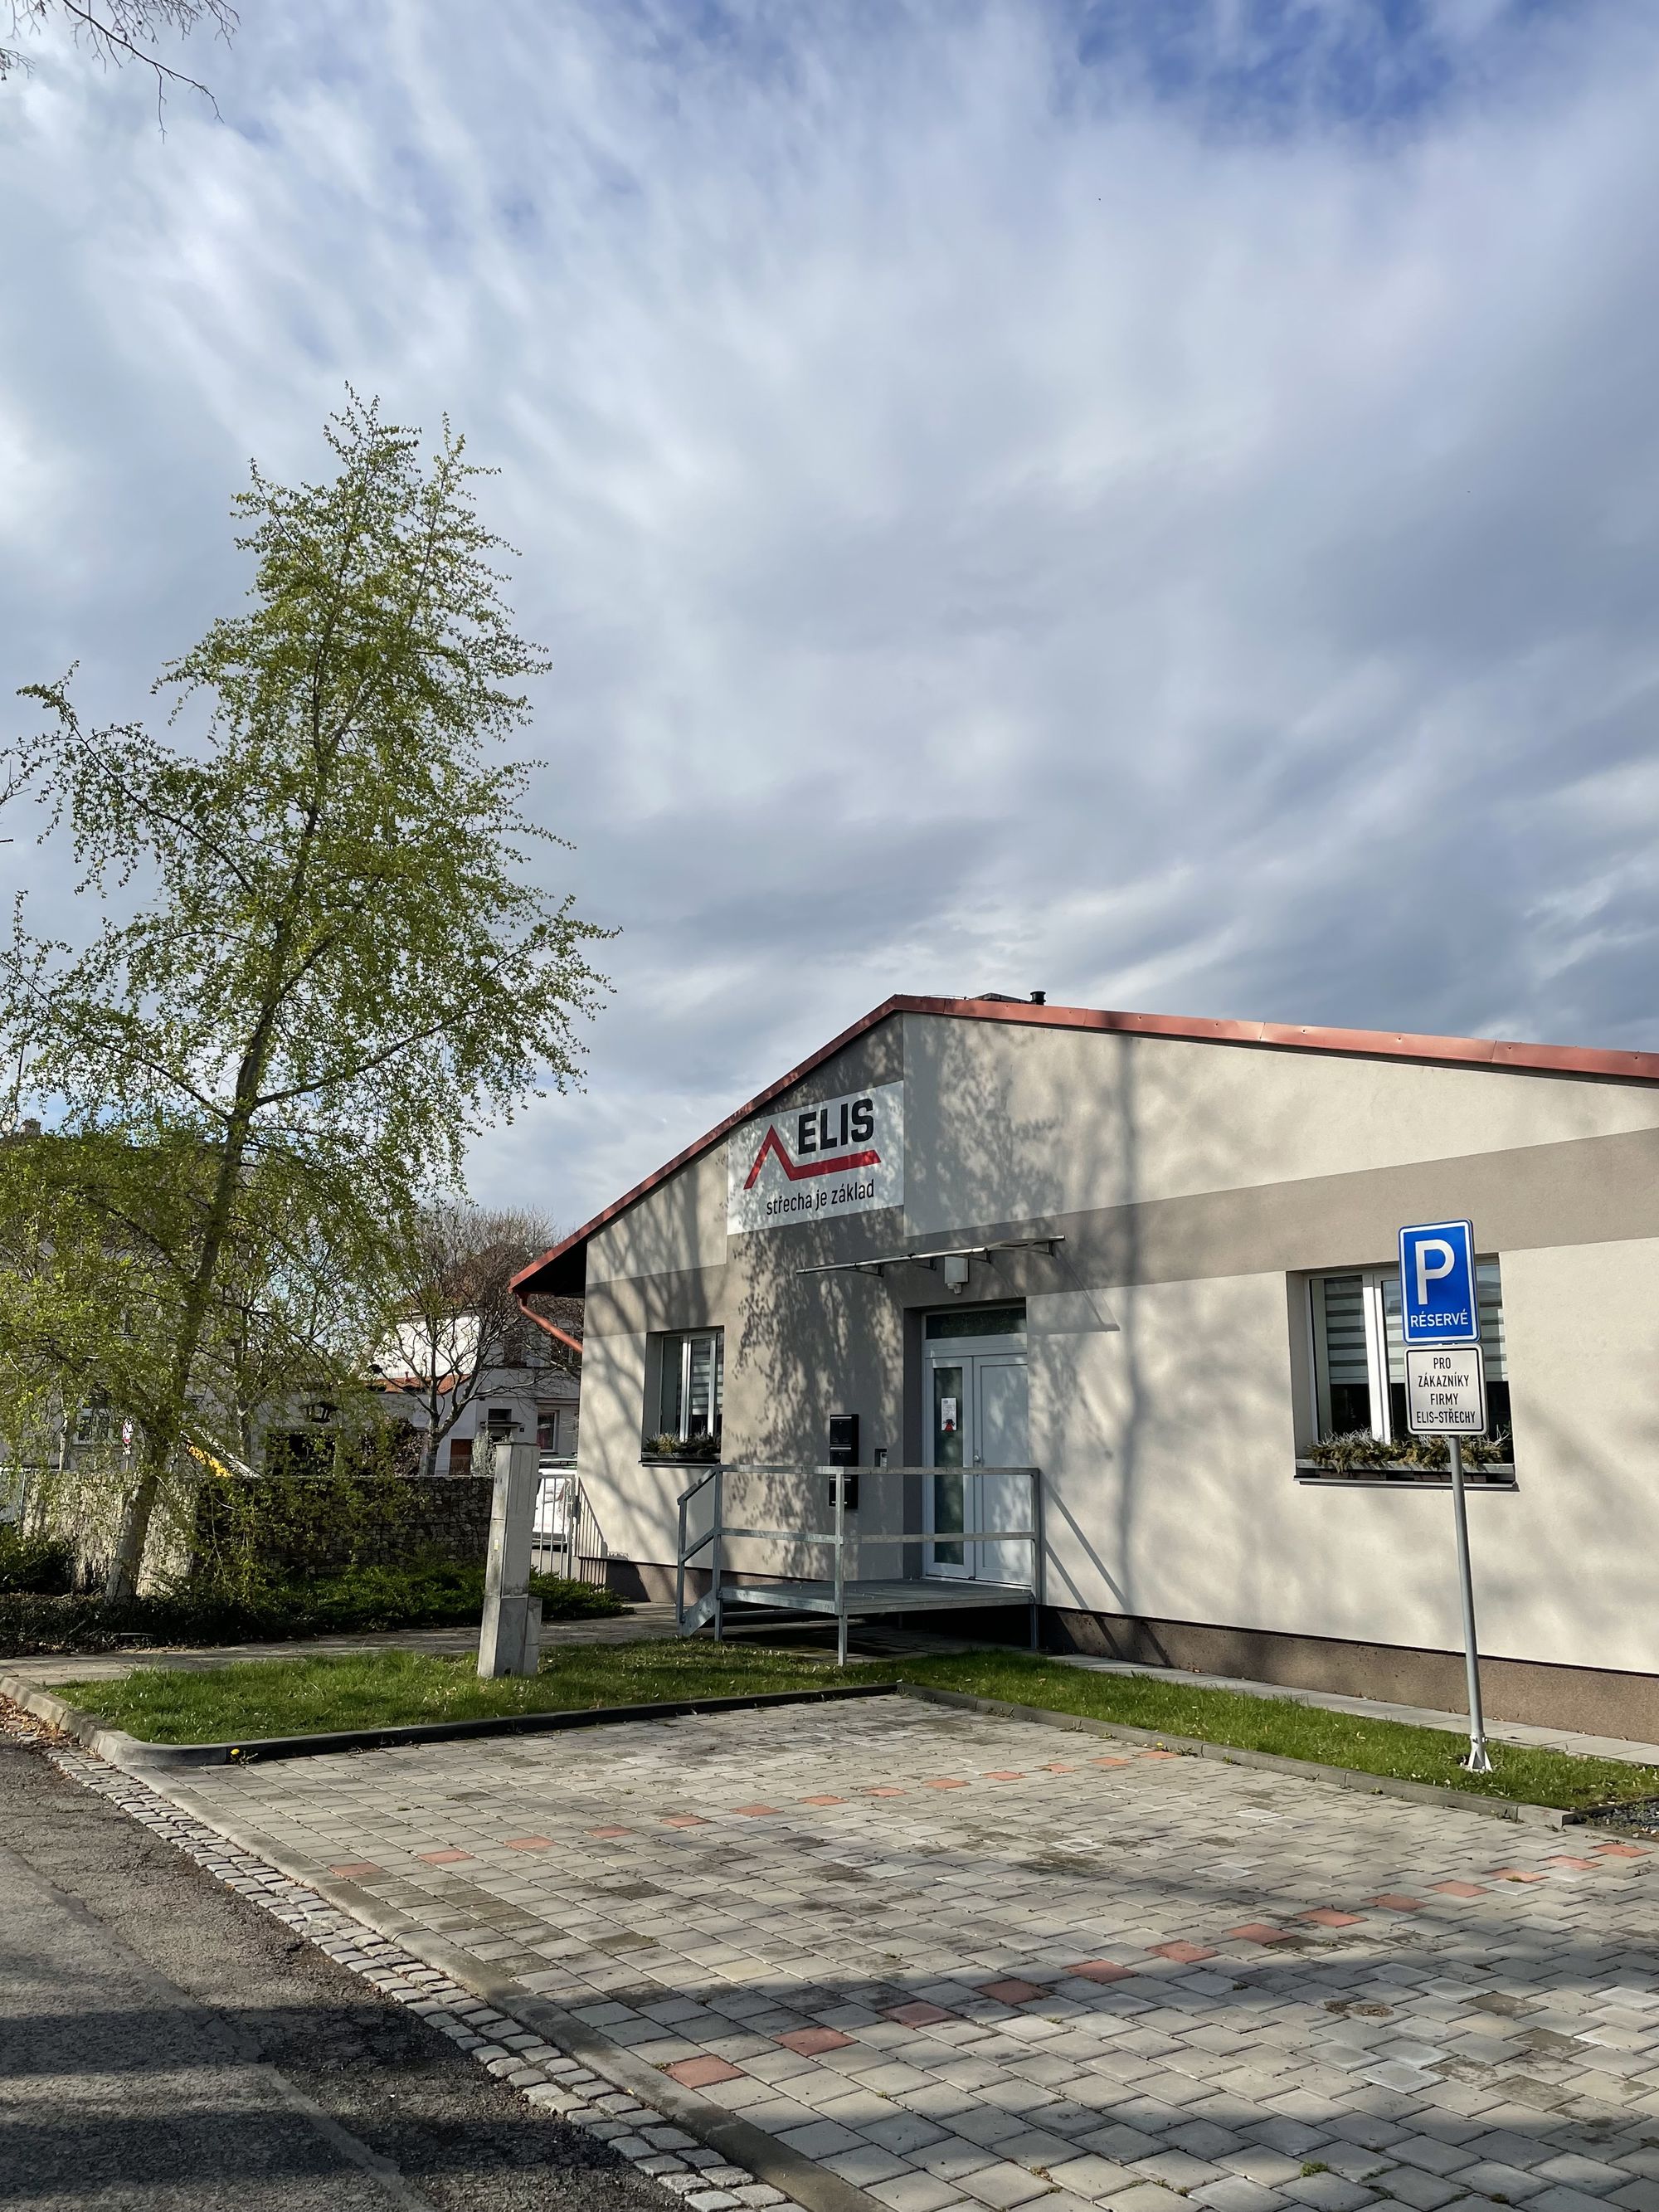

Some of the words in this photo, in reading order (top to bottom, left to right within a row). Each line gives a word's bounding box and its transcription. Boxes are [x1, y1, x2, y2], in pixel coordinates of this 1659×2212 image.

[799, 1098, 874, 1155] ELIS
[766, 1192, 812, 1215] střecha
[815, 1190, 827, 1211] je
[831, 1179, 874, 1204] základ
[1415, 1239, 1455, 1305] P
[1410, 1308, 1468, 1328] RÉSERVÉ
[1433, 1357, 1452, 1369] PRO
[1418, 1372, 1469, 1387] ZÁKAZNÍKY
[1430, 1393, 1458, 1405] FIRMY
[1416, 1408, 1476, 1424] ELIS-STŘECHY
